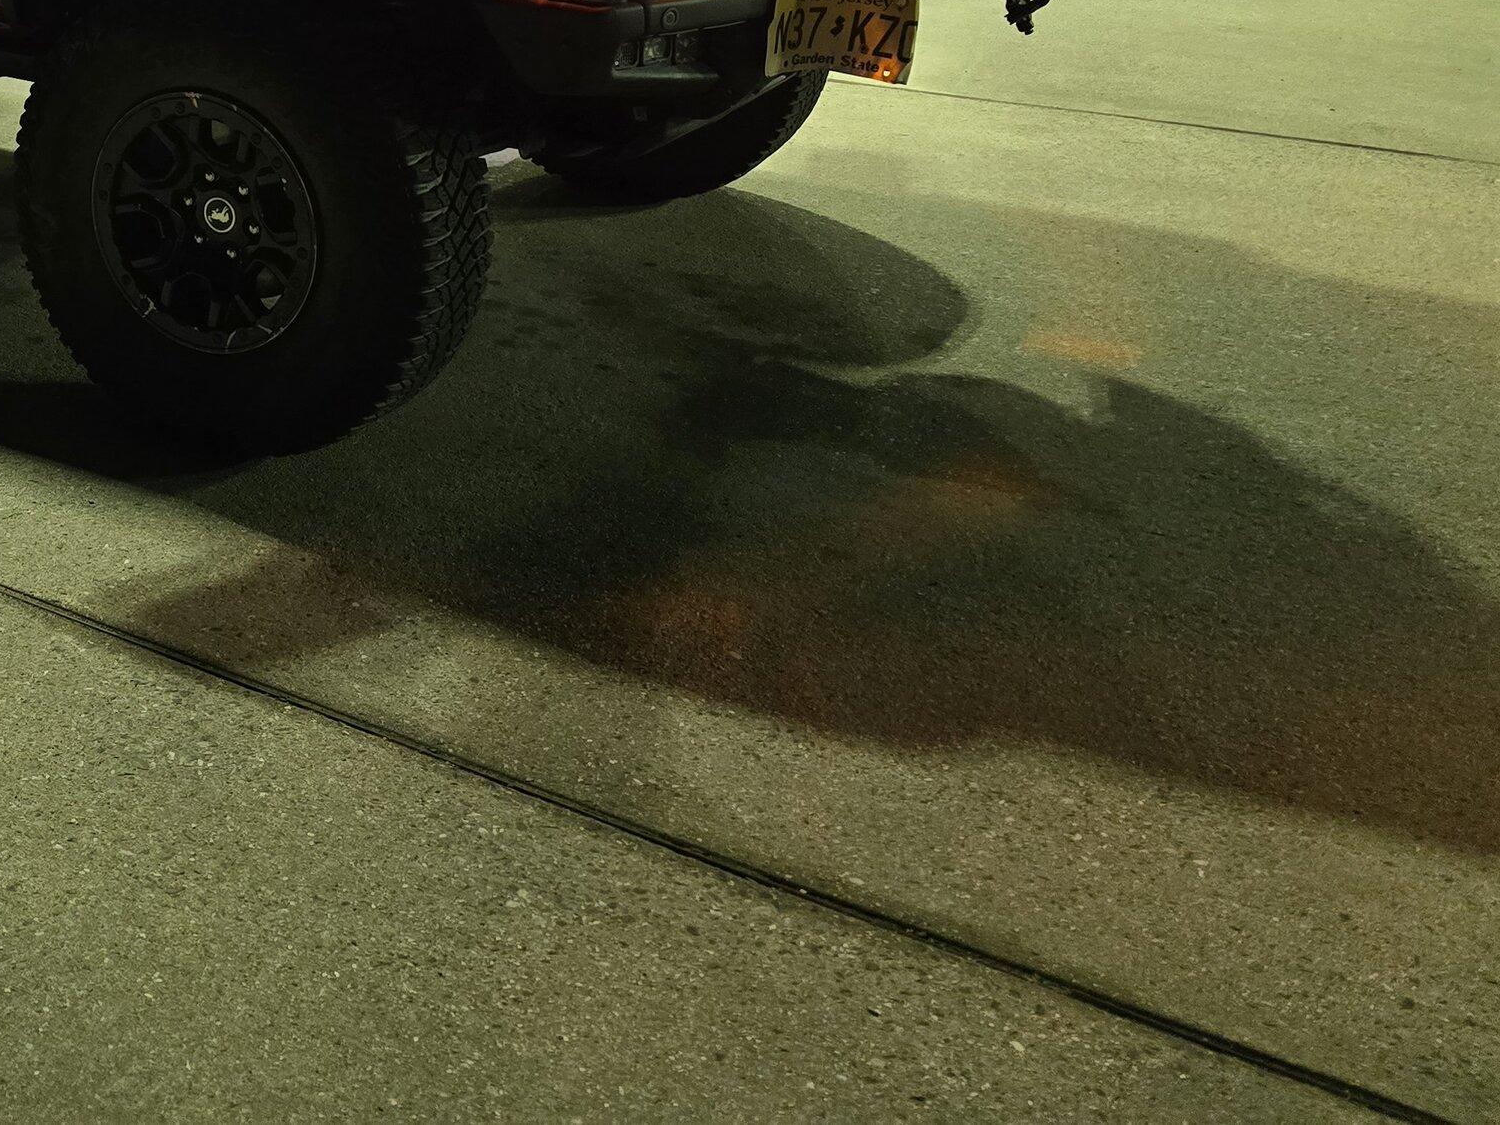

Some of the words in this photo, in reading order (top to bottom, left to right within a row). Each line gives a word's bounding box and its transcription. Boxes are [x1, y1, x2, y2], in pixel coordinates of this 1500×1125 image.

[773, 6, 828, 55] N37
[791, 53, 835, 66] Garden
[839, 54, 880, 73] State
